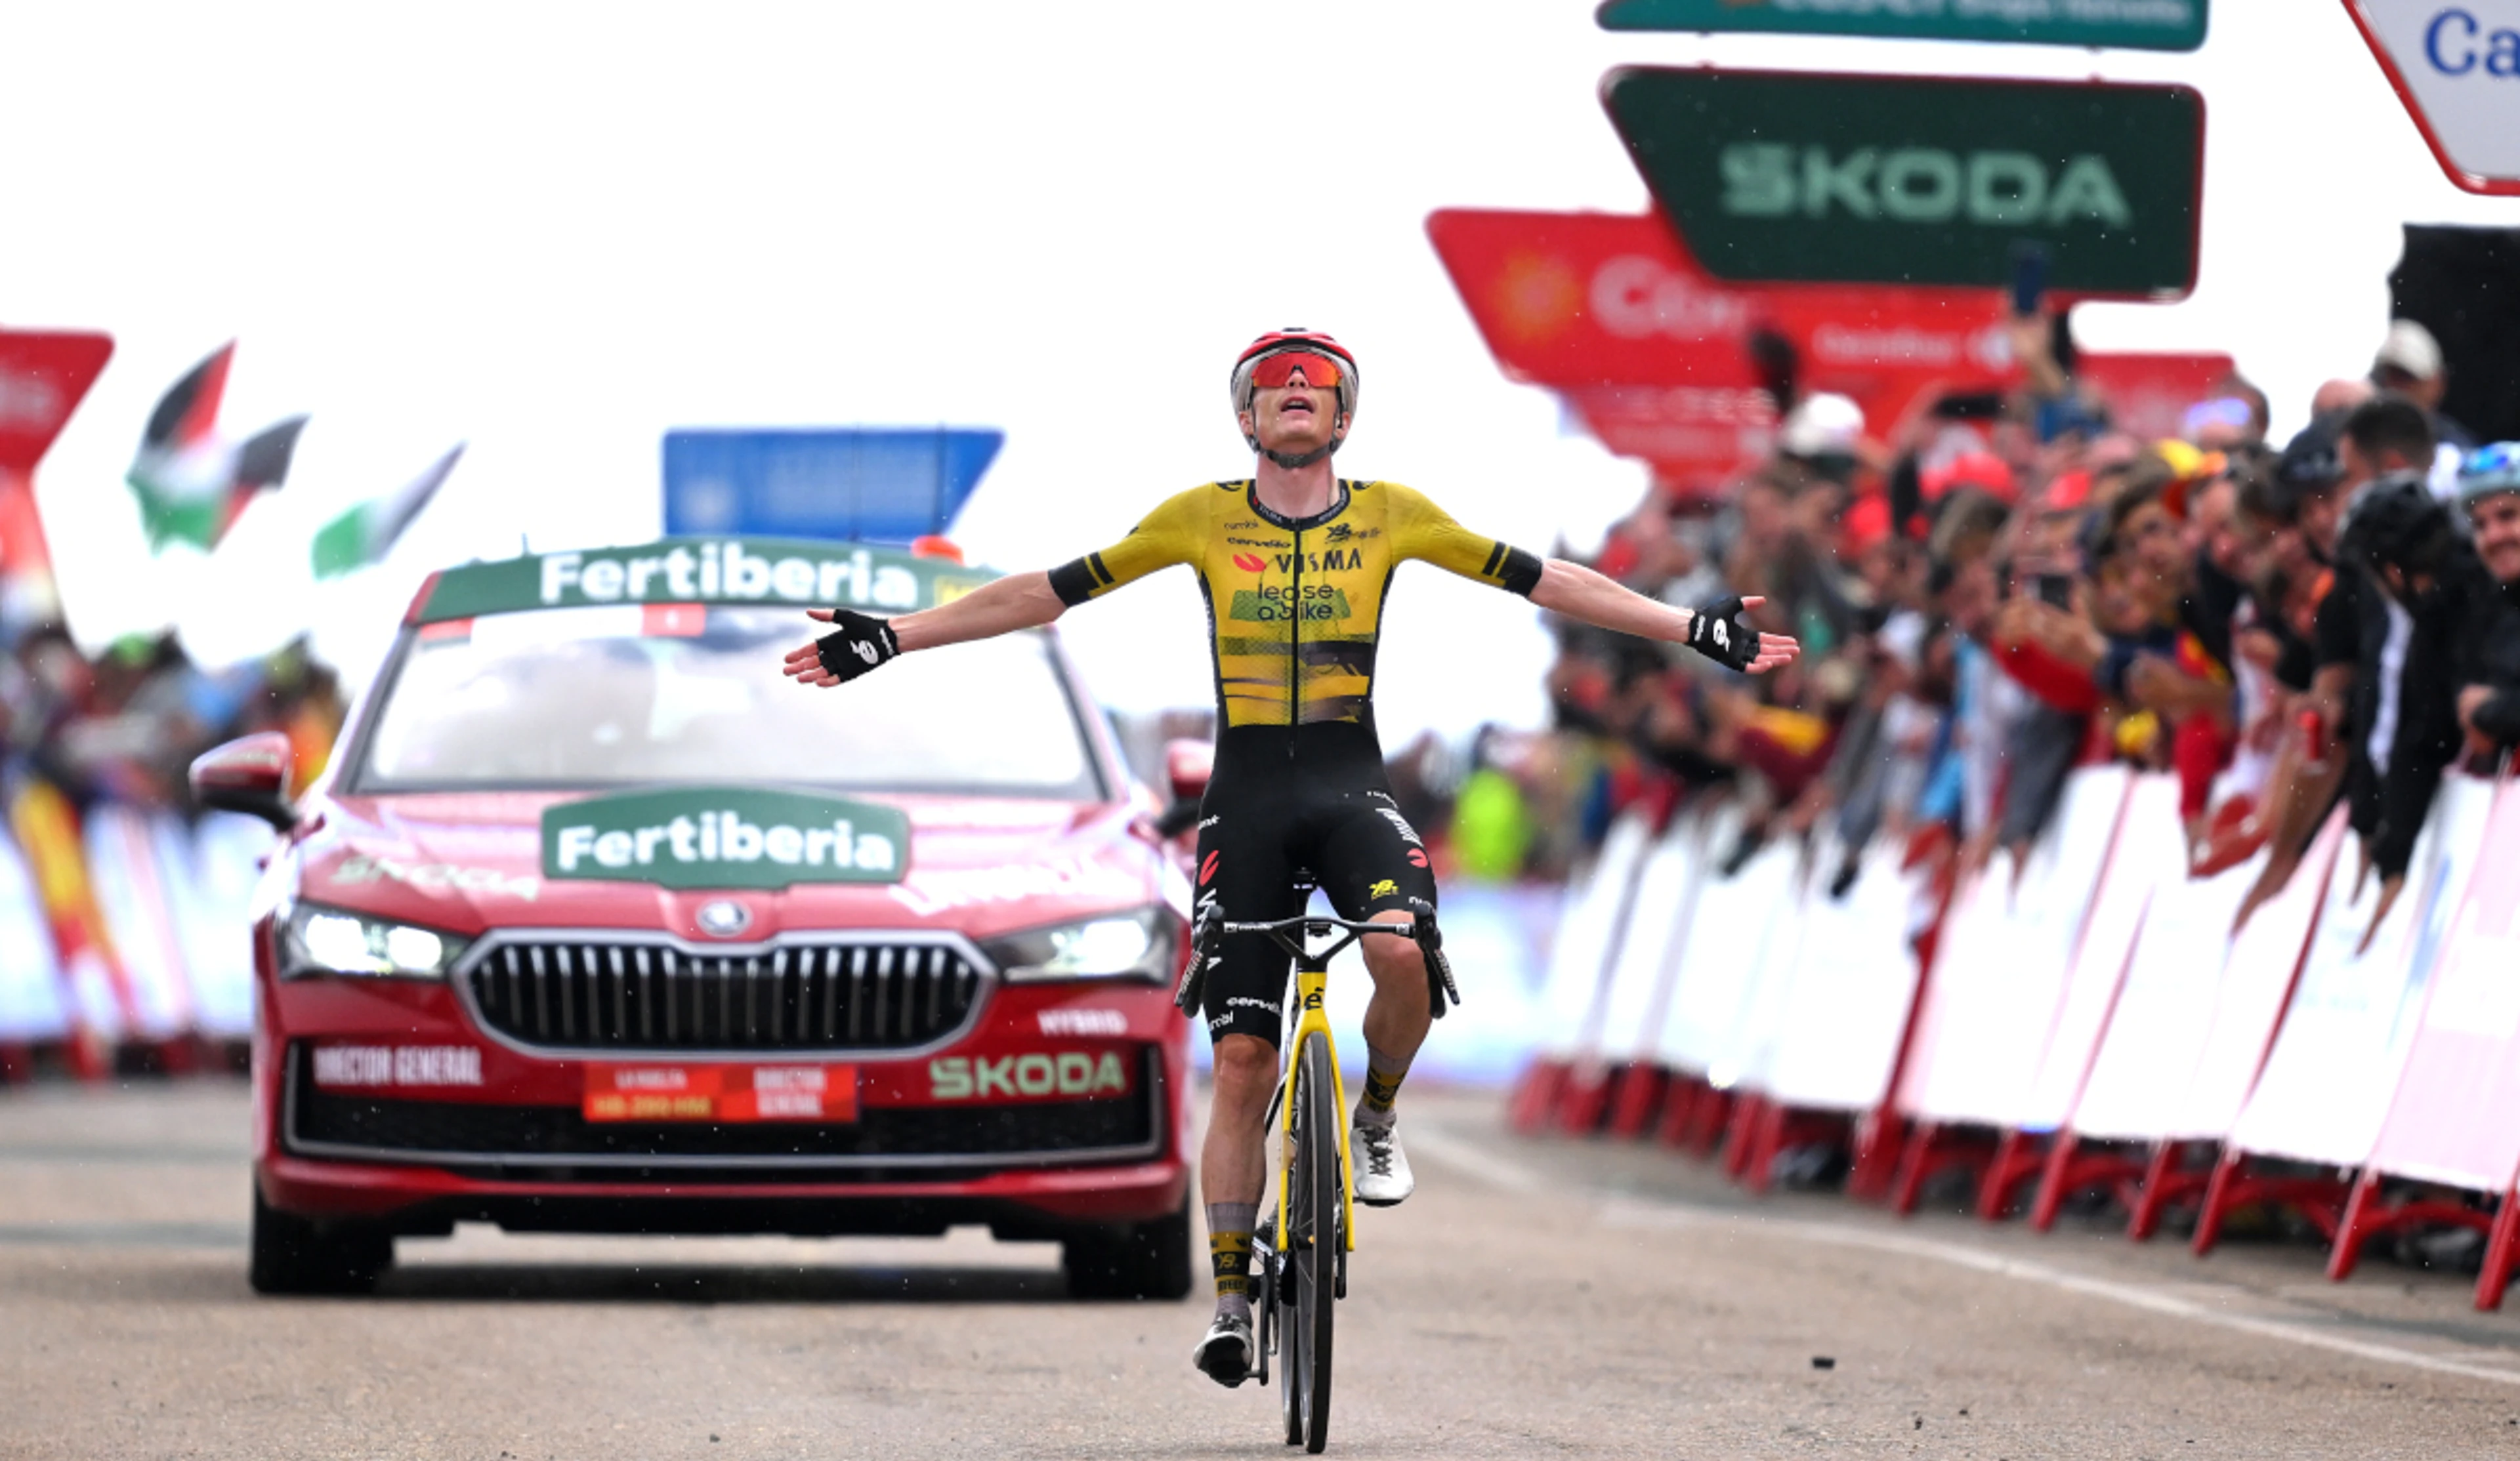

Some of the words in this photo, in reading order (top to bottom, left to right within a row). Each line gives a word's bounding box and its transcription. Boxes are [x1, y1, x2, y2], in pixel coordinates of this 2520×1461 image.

[539, 543, 919, 605] Fertiberia
[1275, 547, 1363, 574] VISMA
[1258, 582, 1334, 600] lease
[557, 810, 894, 871] Fertiberia
[929, 1052, 1125, 1098] SKODA
